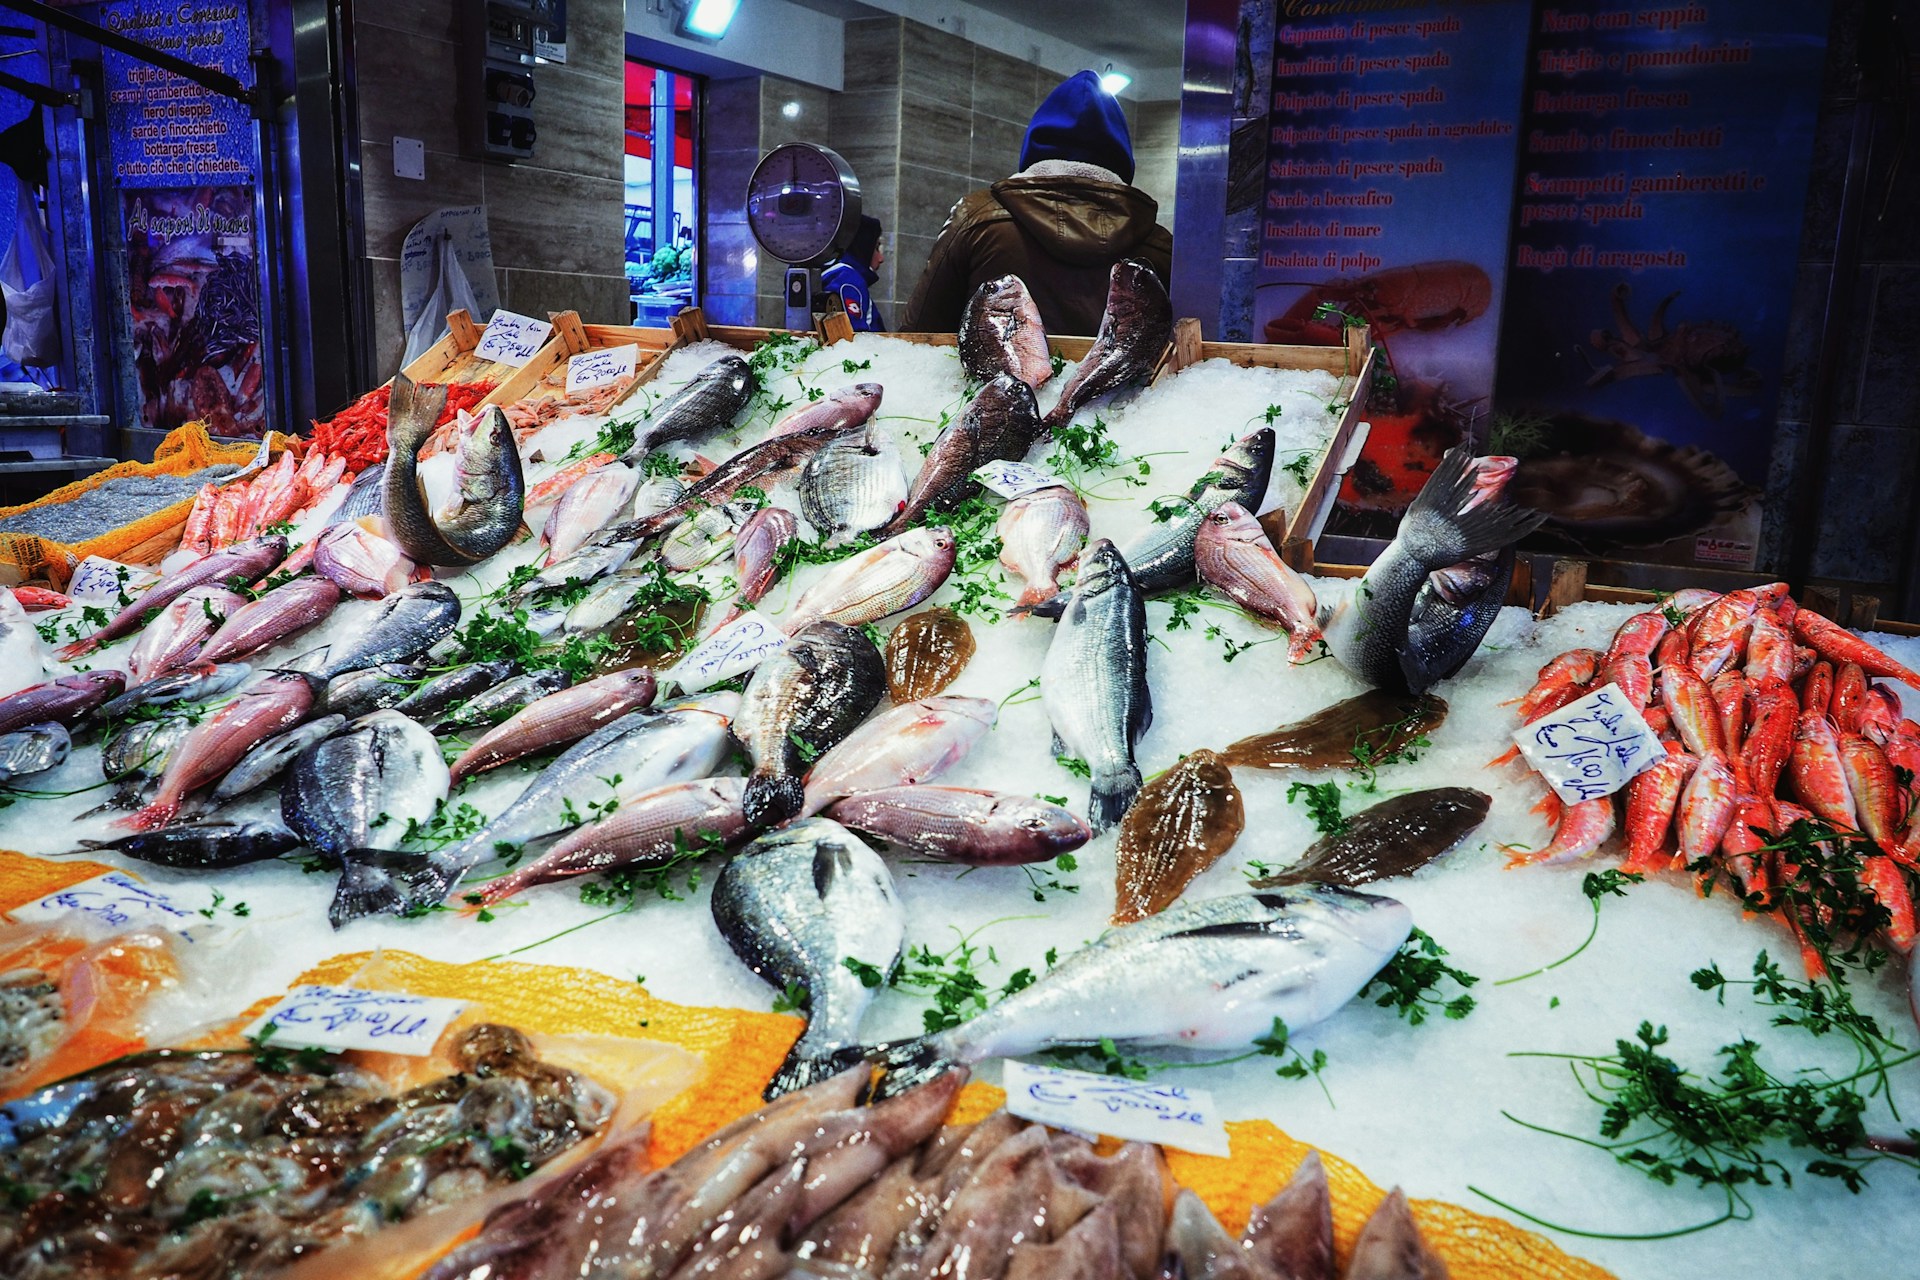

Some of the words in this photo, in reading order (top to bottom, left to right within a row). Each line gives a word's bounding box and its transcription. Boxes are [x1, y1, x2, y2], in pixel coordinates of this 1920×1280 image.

[177, 4, 238, 23] Cortesia
[1542, 11, 1589, 30] Nero
[1594, 14, 1631, 28] con
[1637, 2, 1707, 30] seppia
[1280, 26, 1345, 44] Caponata
[1351, 22, 1364, 37] di
[1369, 25, 1409, 41] pesce
[1415, 17, 1460, 37] spada
[187, 31, 224, 55] posto
[1278, 57, 1336, 75] Involtini
[1341, 55, 1354, 71] di
[1360, 59, 1400, 75] pesce
[1405, 51, 1450, 71] spada
[1540, 49, 1602, 75] Triglie
[1609, 54, 1620, 67] e
[1625, 41, 1750, 74] pomodorini
[128, 68, 155, 84] triglie
[158, 70, 165, 80] e
[111, 88, 144, 103] scampi
[147, 86, 201, 102] gamberetto
[1275, 93, 1331, 111] Polpette
[1336, 90, 1349, 106] di
[1354, 93, 1394, 110] pesce
[1400, 86, 1443, 107] spada
[1534, 91, 1619, 115] Bottarga
[1625, 87, 1690, 108] fresca
[144, 107, 165, 118] nero
[168, 104, 177, 117] di
[179, 104, 211, 119] seppia
[132, 125, 158, 138] sarde
[161, 128, 166, 136] e
[169, 122, 227, 136] finocchietto
[1273, 127, 1322, 145] Polpette
[1327, 124, 1338, 140] di
[1343, 127, 1379, 143] pesce
[1383, 122, 1422, 142] spada
[1428, 123, 1439, 137] in
[1444, 121, 1512, 138] agrodolce
[1529, 130, 1586, 151] Sarde
[1610, 126, 1723, 149] finocchetti
[144, 142, 184, 157] bottarga
[186, 141, 217, 154] fresca
[118, 165, 124, 174] e
[126, 162, 148, 174] tutto
[150, 162, 164, 174] ciò
[167, 160, 183, 173] che
[186, 160, 195, 172] ci
[1270, 160, 1331, 177] Salsiccia
[1336, 160, 1349, 175] di
[1354, 163, 1394, 179] pesce
[1399, 157, 1443, 177] spada
[1525, 172, 1625, 199] Scampetti
[1630, 171, 1748, 195] gamberetti
[1753, 176, 1765, 190] e
[1268, 191, 1308, 207] Sarde
[1312, 196, 1321, 207] a
[1325, 190, 1393, 206] beccafico
[151, 211, 194, 244] sapori
[196, 203, 211, 234] di
[214, 214, 250, 234] mare
[1521, 203, 1577, 226] pesce
[1583, 199, 1643, 224] spada
[1266, 222, 1321, 237] Insalata
[1326, 222, 1339, 237] di
[1343, 226, 1382, 237] mare
[1264, 252, 1318, 267] Insalata
[1323, 252, 1336, 267] di
[1341, 252, 1381, 271] polpo
[1518, 245, 1568, 271] Ragù
[1572, 245, 1595, 267] di
[1598, 249, 1687, 271] aragosta
